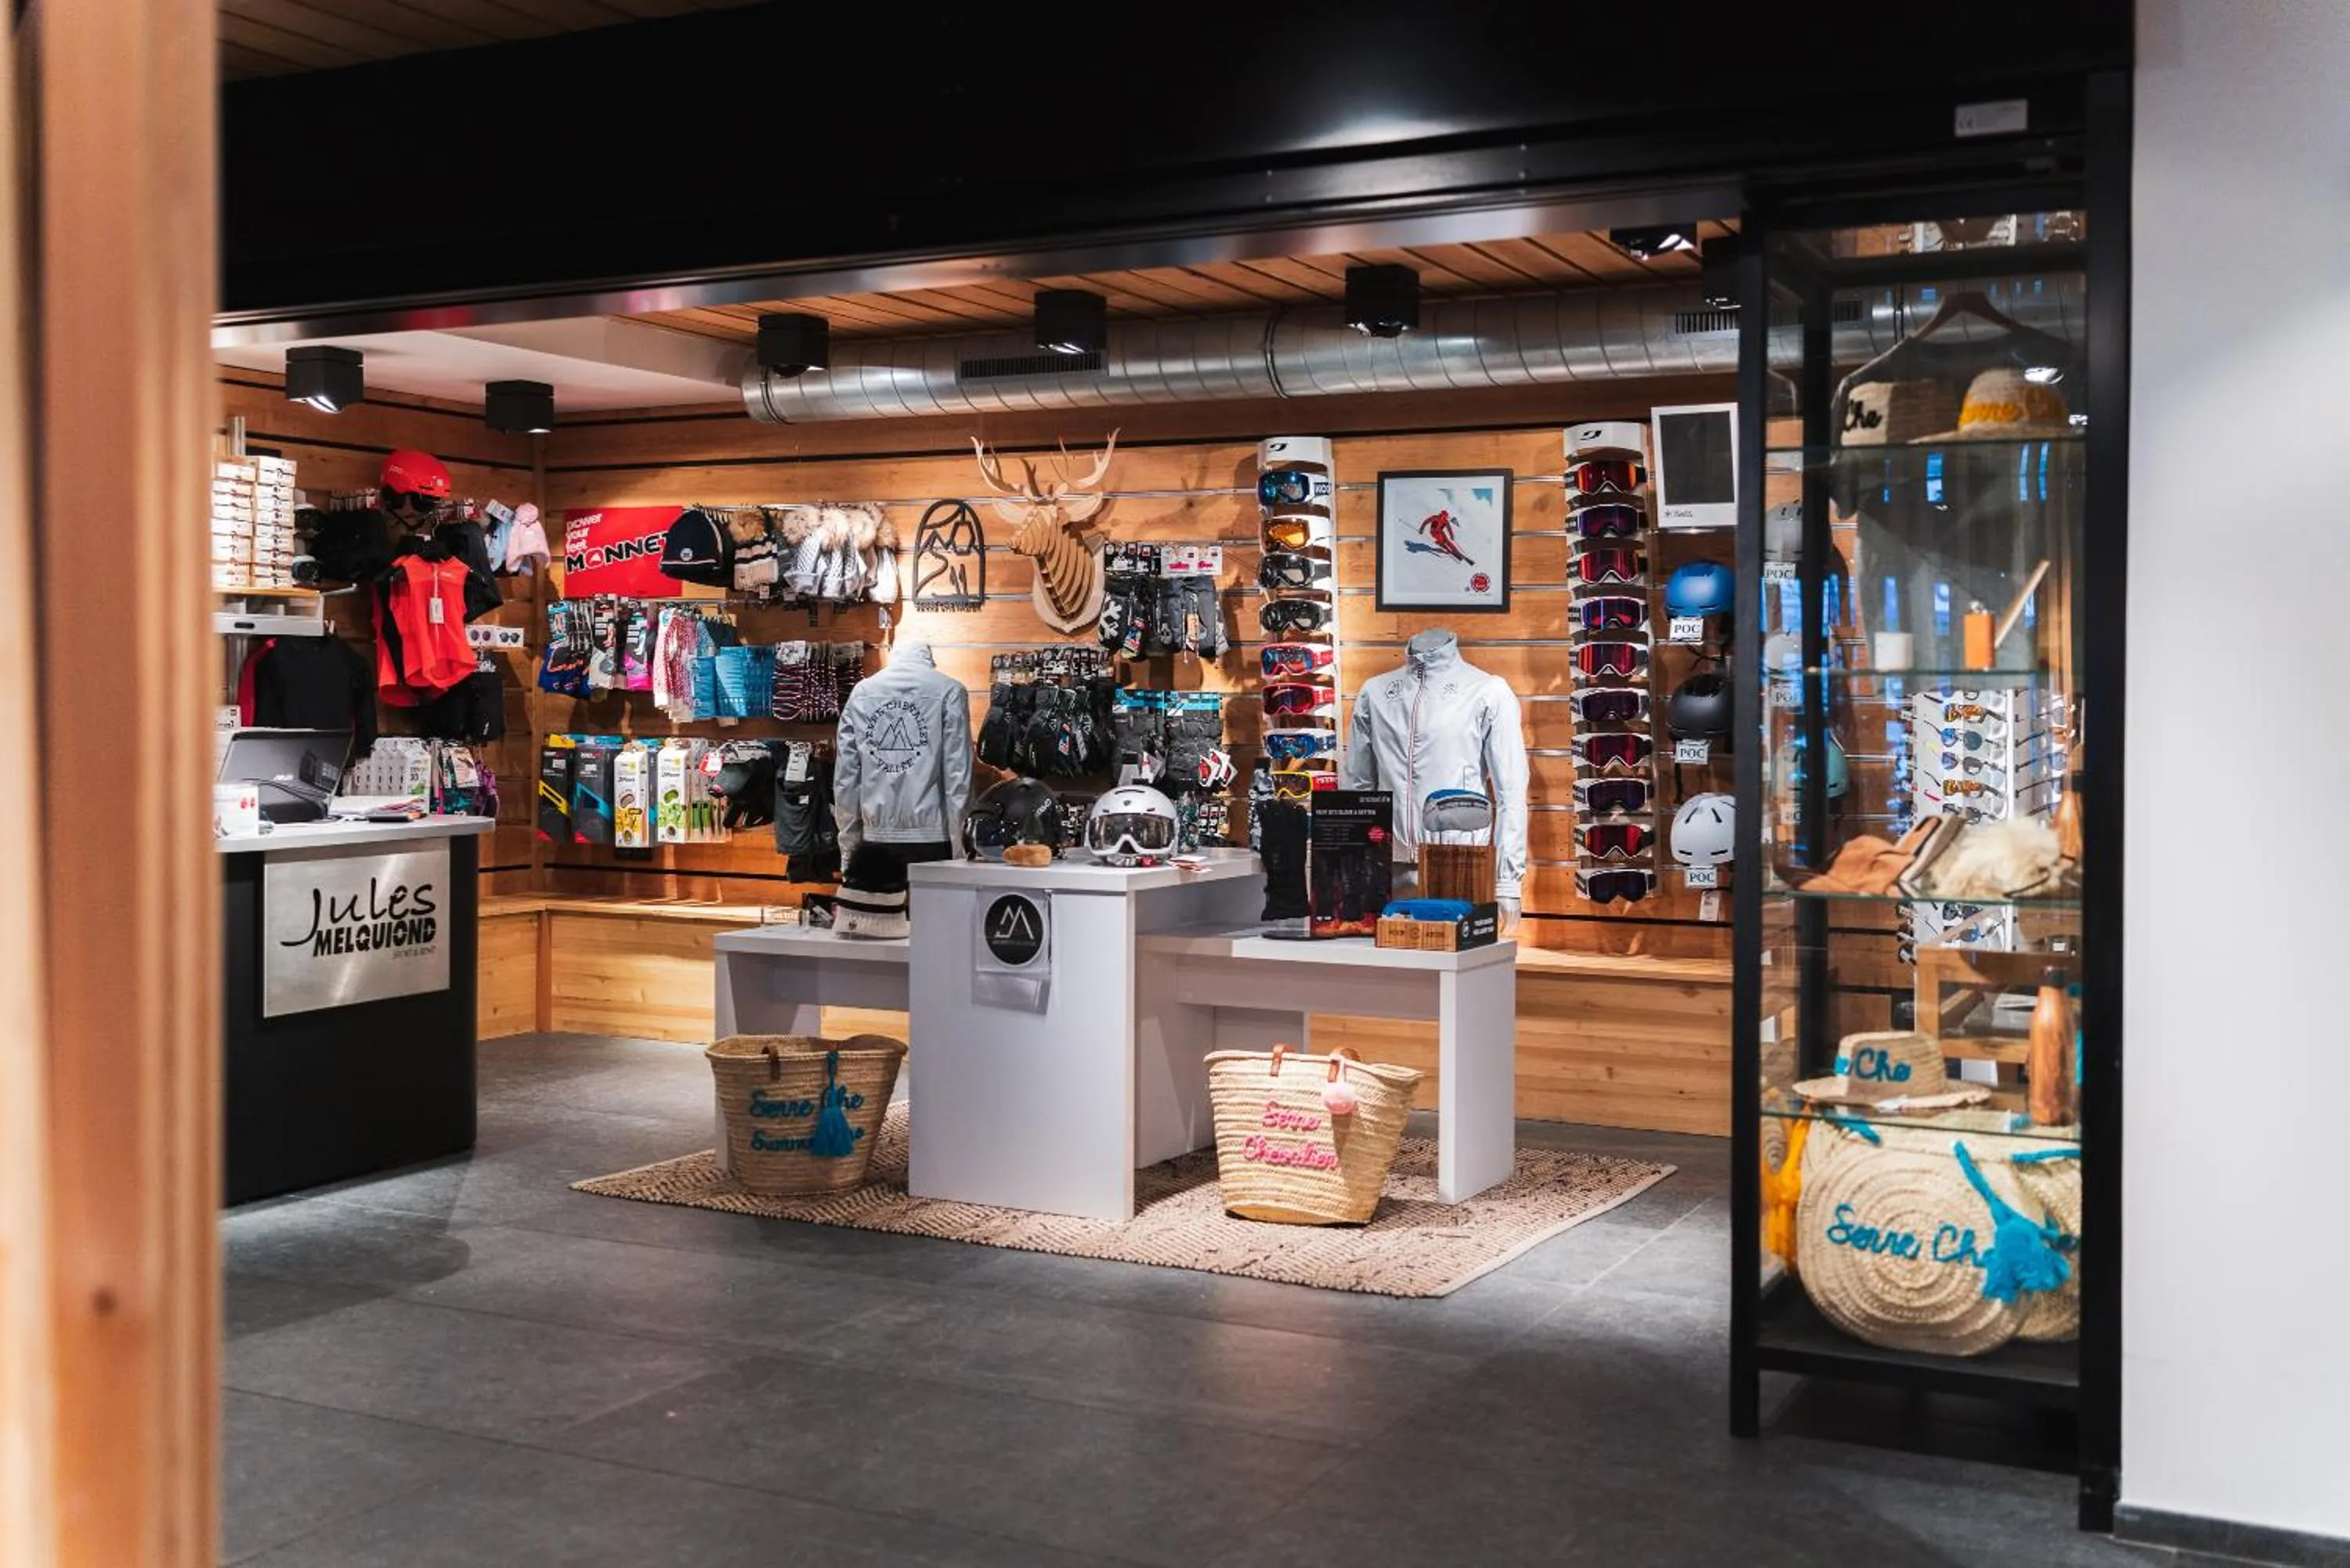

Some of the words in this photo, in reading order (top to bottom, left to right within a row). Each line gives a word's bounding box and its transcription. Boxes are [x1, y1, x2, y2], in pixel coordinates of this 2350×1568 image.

[566, 514, 602, 531] power
[566, 528, 589, 540] your
[566, 539, 588, 553] feet
[1766, 569, 1793, 580] POC
[1673, 623, 1701, 634] POC
[1679, 746, 1706, 760] POC
[1689, 871, 1716, 884] POC
[280, 876, 436, 946] Jules
[313, 917, 436, 957] MELQUIOND
[1856, 1046, 1912, 1082] Che
[750, 1089, 815, 1118] Serre
[1826, 1203, 1922, 1260] Serre
